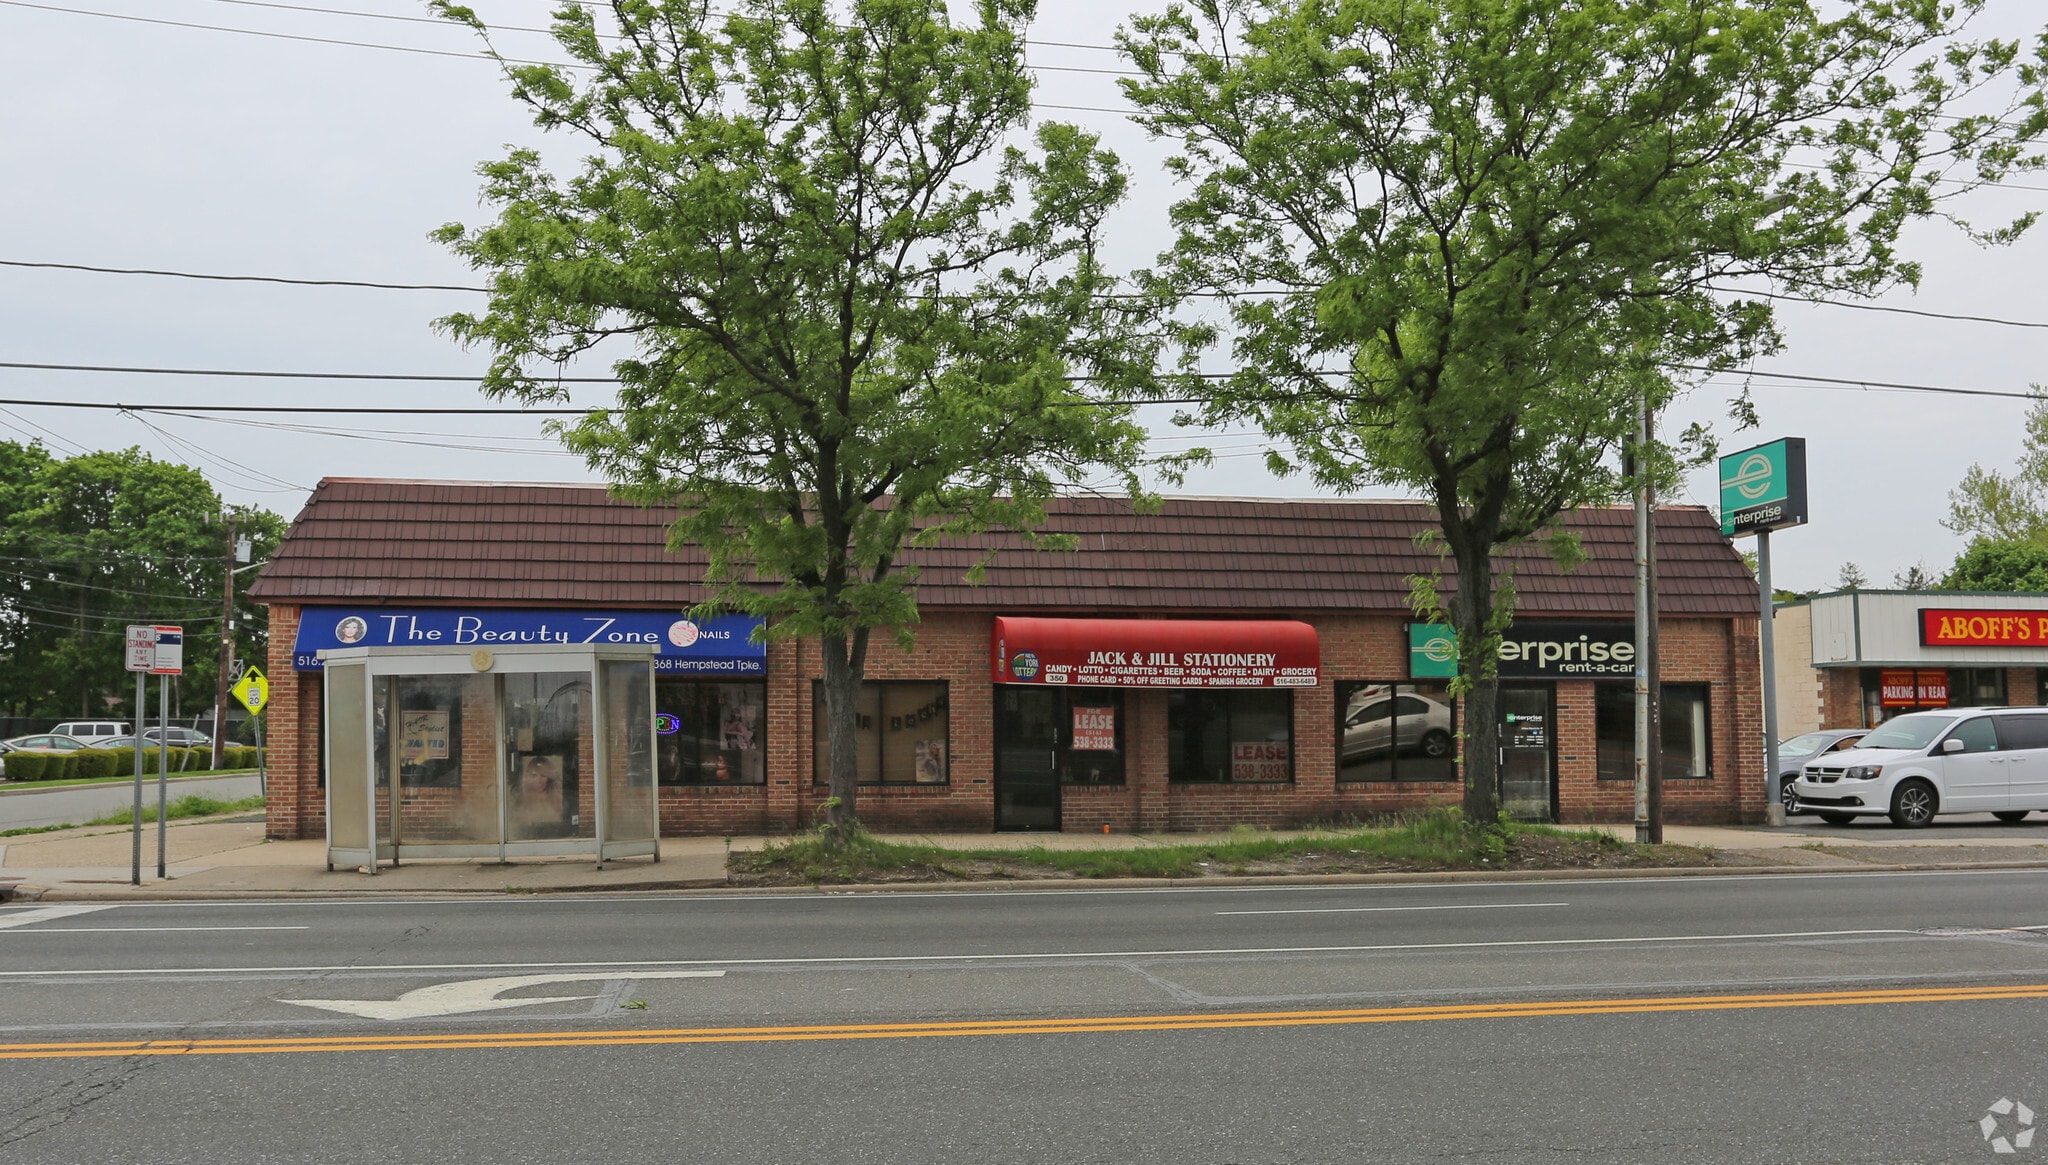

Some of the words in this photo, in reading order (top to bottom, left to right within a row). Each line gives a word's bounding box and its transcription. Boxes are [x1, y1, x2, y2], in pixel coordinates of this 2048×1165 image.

[1722, 506, 1781, 527] enterprise
[136, 630, 148, 639] NO
[380, 615, 442, 643] The
[453, 616, 568, 644] Beauty
[581, 617, 659, 643] Zone
[1937, 616, 2031, 640] ABOFF'S
[699, 631, 730, 640] NAILS
[128, 639, 155, 649] STANDING
[653, 659, 672, 669] 368
[675, 658, 734, 670] Hempstead
[737, 659, 762, 670] Tpke.
[1088, 651, 1127, 665] JACK
[1131, 652, 1143, 665] &
[1147, 653, 1179, 666] JILL
[1183, 653, 1276, 667] STATIONERY
[1045, 664, 1072, 673] CANDY
[1078, 665, 1104, 674] LOTTO
[1109, 666, 1158, 675] CIGARETTES
[1164, 667, 1184, 676] BEER
[1191, 668, 1211, 676] SODA
[1217, 668, 1246, 676] COFFEE
[1252, 668, 1276, 676] DAIRY
[1281, 667, 1317, 676] GROCERY
[1559, 661, 1635, 673] rent-a-car
[1077, 674, 1099, 683] PHONE
[1122, 676, 1136, 684] 50%
[1150, 677, 1181, 685] GREETING
[1182, 677, 1203, 685] CARDS
[1208, 677, 1235, 685] SPANISH
[1235, 677, 1264, 685] GROCERY
[1883, 686, 1914, 699] PARKING
[1918, 686, 1926, 699] IN
[1928, 686, 1946, 699] REAR
[249, 696, 260, 705] 20
[1074, 714, 1113, 730] LEASE
[1073, 735, 1114, 749] 538-3333
[1234, 745, 1287, 760] LEASE
[1234, 763, 1288, 780] 538-3333
